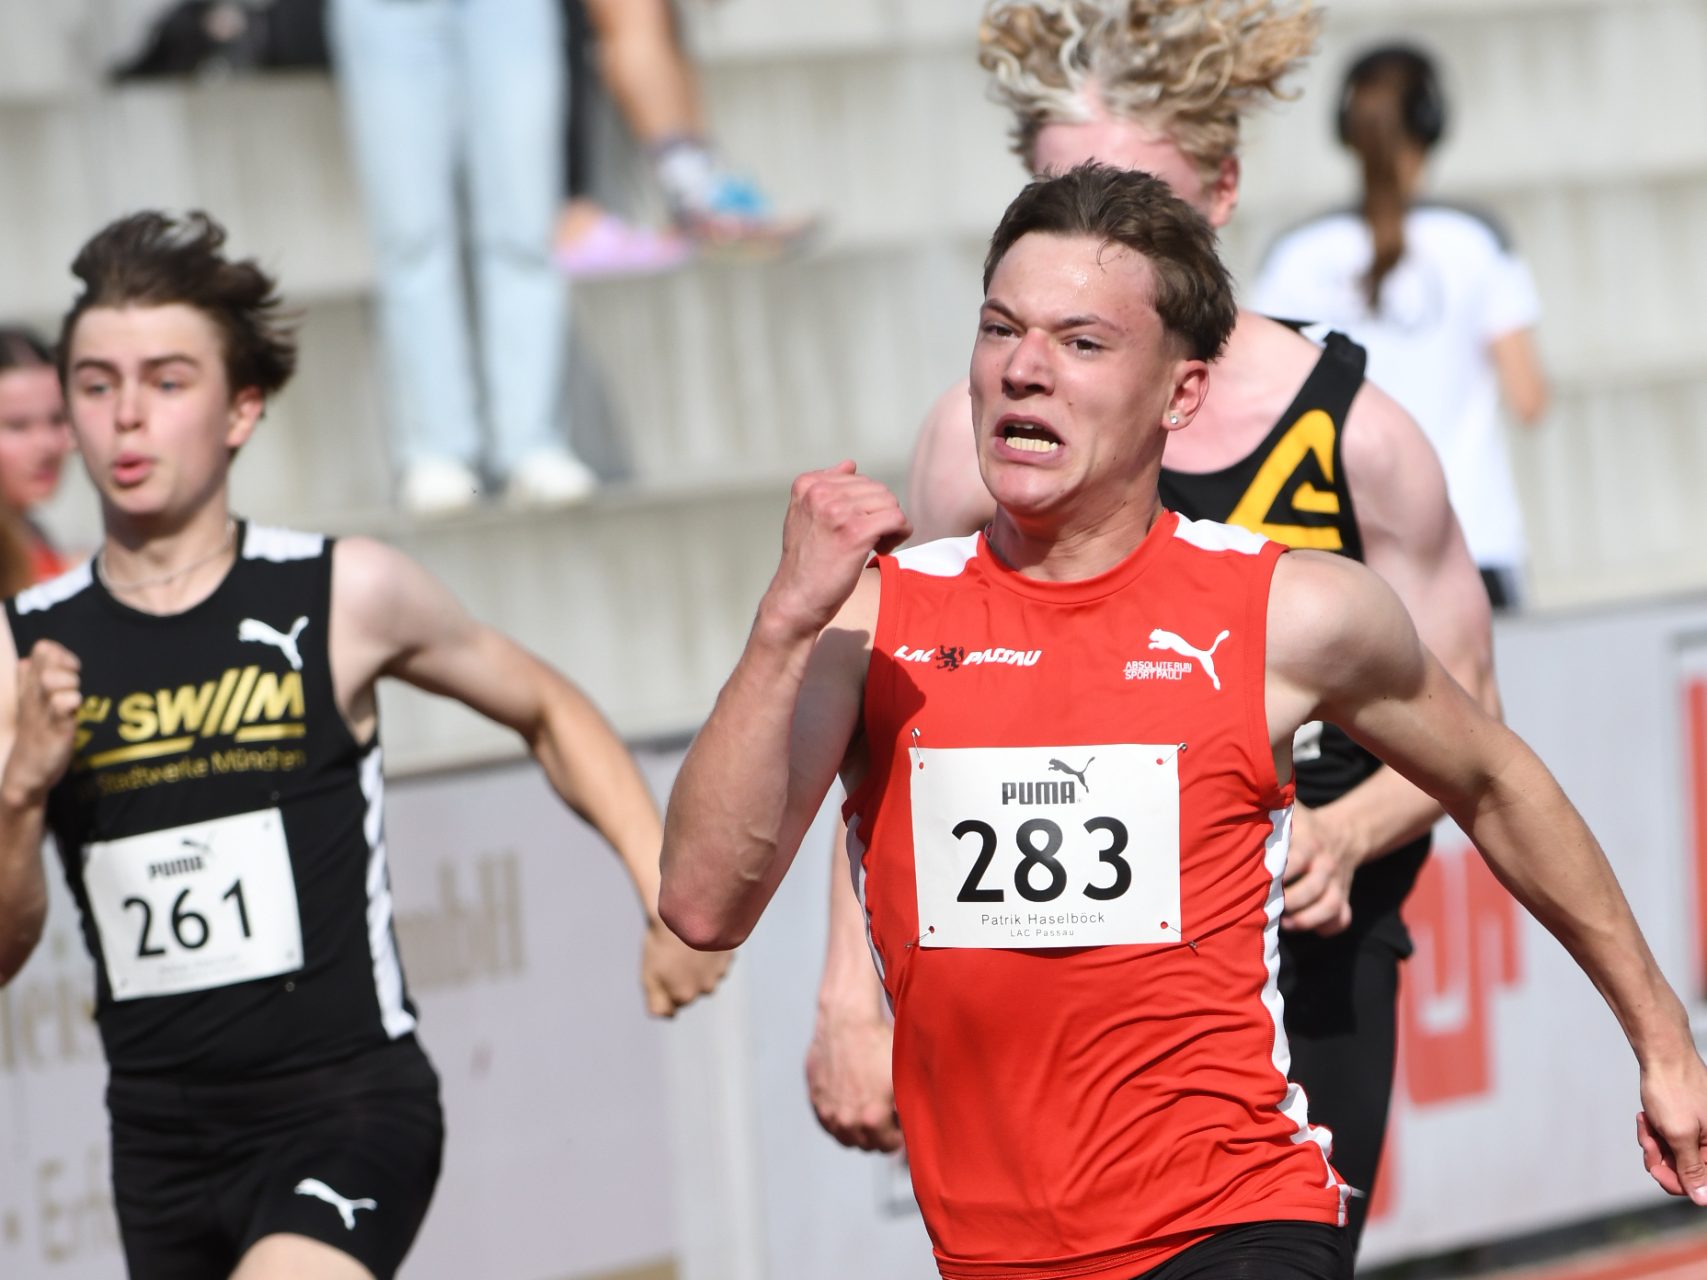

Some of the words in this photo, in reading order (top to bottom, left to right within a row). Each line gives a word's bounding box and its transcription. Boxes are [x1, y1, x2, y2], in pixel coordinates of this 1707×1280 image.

[1002, 781, 1075, 806] PUMA
[951, 816, 1132, 903] 283
[123, 876, 253, 958] 261
[981, 914, 1021, 926] Patrik
[1028, 912, 1105, 925] Haselböck
[1010, 929, 1031, 937] LAC
[1035, 929, 1075, 937] Passau
